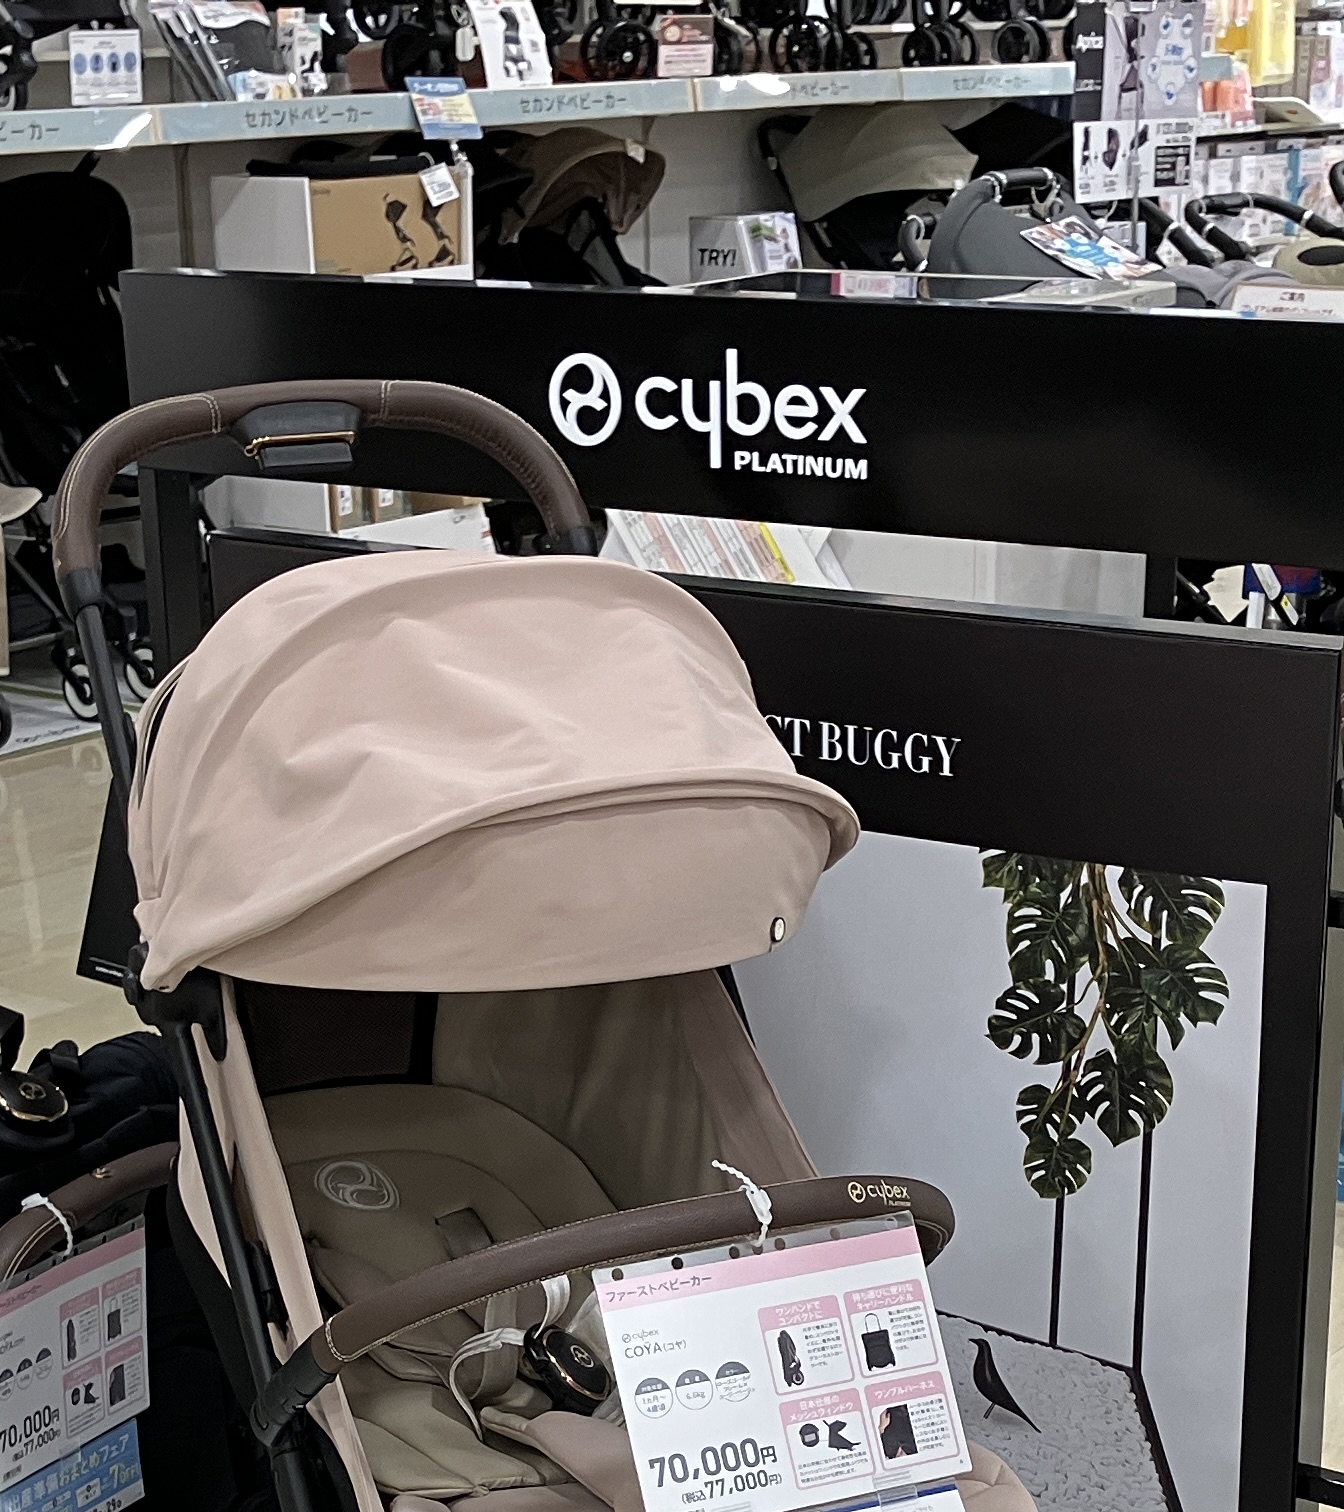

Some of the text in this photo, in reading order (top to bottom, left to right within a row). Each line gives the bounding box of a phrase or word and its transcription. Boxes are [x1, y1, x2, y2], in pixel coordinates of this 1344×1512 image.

[244, 104, 374, 130] セカンドベビーカー
[519, 91, 628, 115] セカンドベビーカー
[696, 248, 738, 268] TRY!
[634, 347, 869, 470] cybex
[734, 449, 869, 481] PLATINUM
[818, 721, 962, 778] BUGGY
[866, 1178, 911, 1206] cybex
[605, 1274, 713, 1303] ファーストベビーカー
[0, 1404, 60, 1455] 70,000円
[647, 1436, 779, 1489] 70,000円
[680, 1468, 784, 1506] (税込77,000円)
